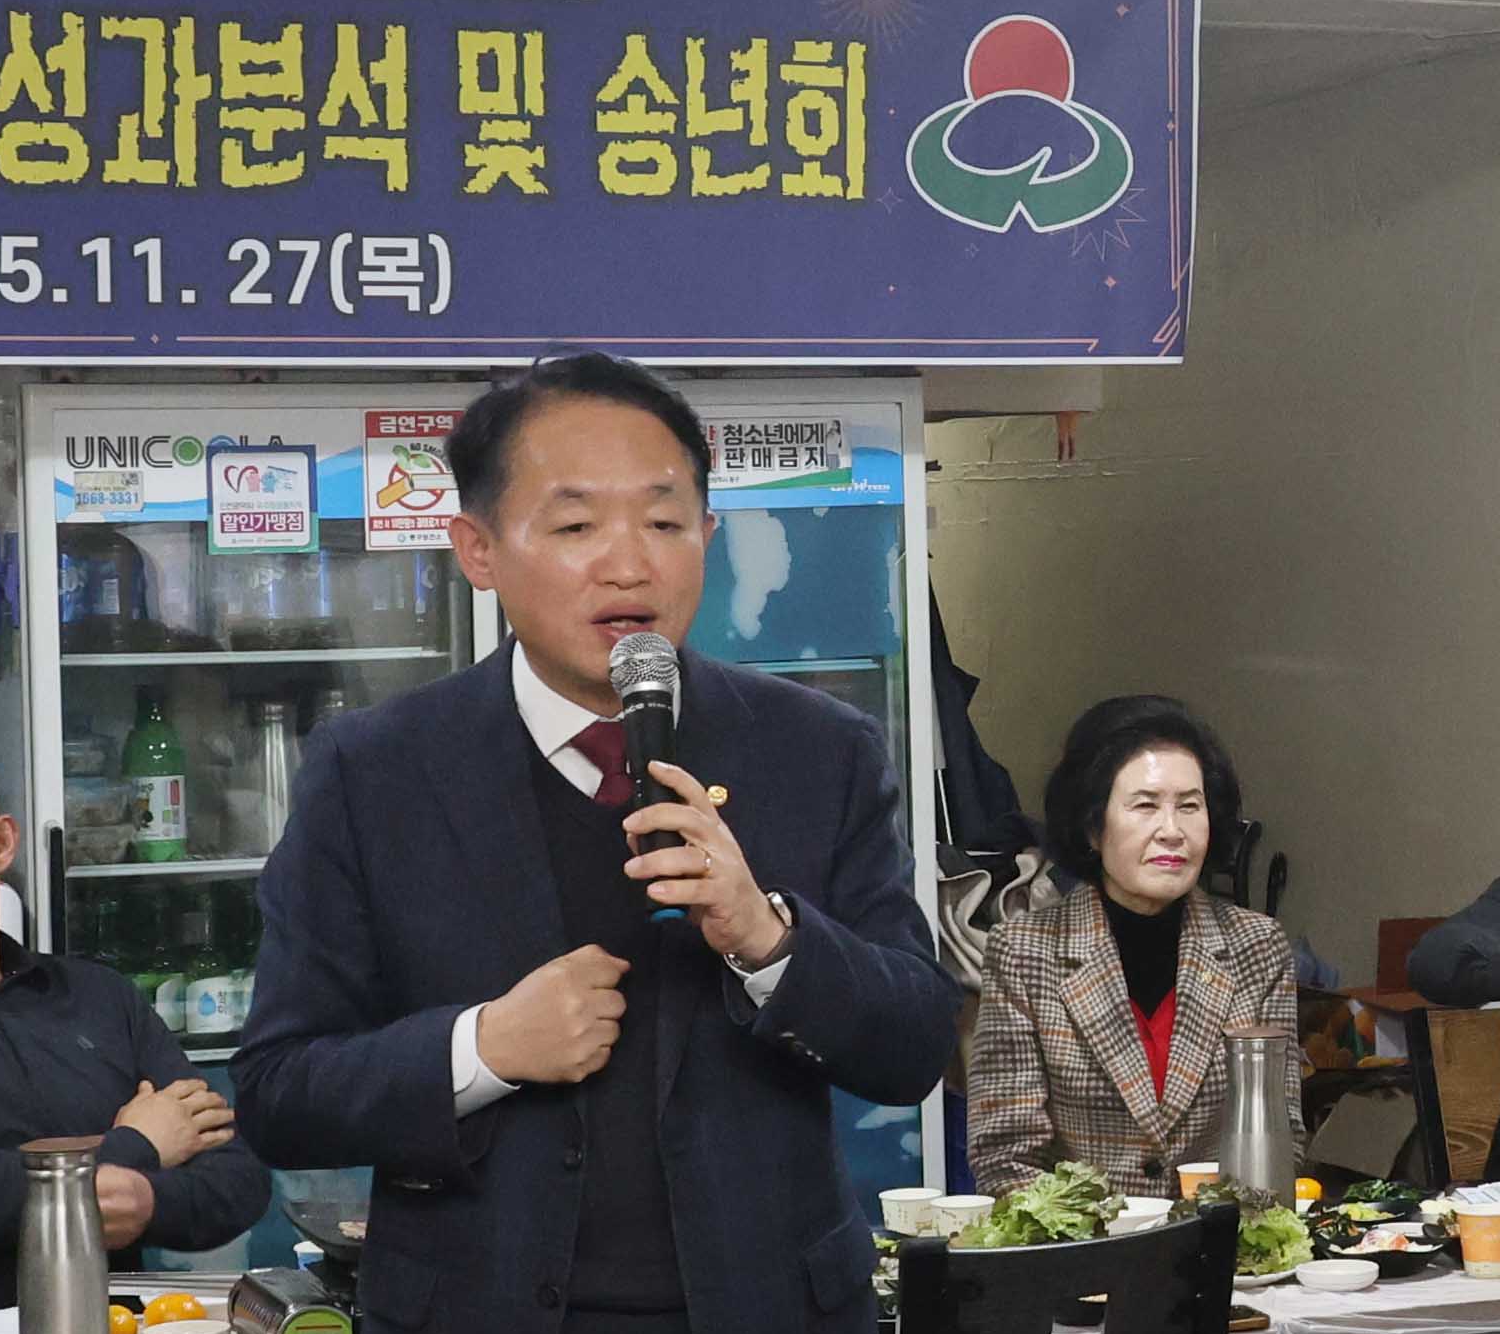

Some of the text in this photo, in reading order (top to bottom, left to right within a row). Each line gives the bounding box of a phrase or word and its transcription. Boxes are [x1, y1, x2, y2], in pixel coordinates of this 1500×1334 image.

[456, 29, 551, 198] 및
[594, 33, 869, 202] 송년회
[226, 230, 453, 315] 27(목)
[379, 415, 454, 434] 금연구역
[722, 422, 825, 447] 청소년에게
[724, 446, 825, 469] 판매금지
[222, 513, 303, 533] 할인가맹점
